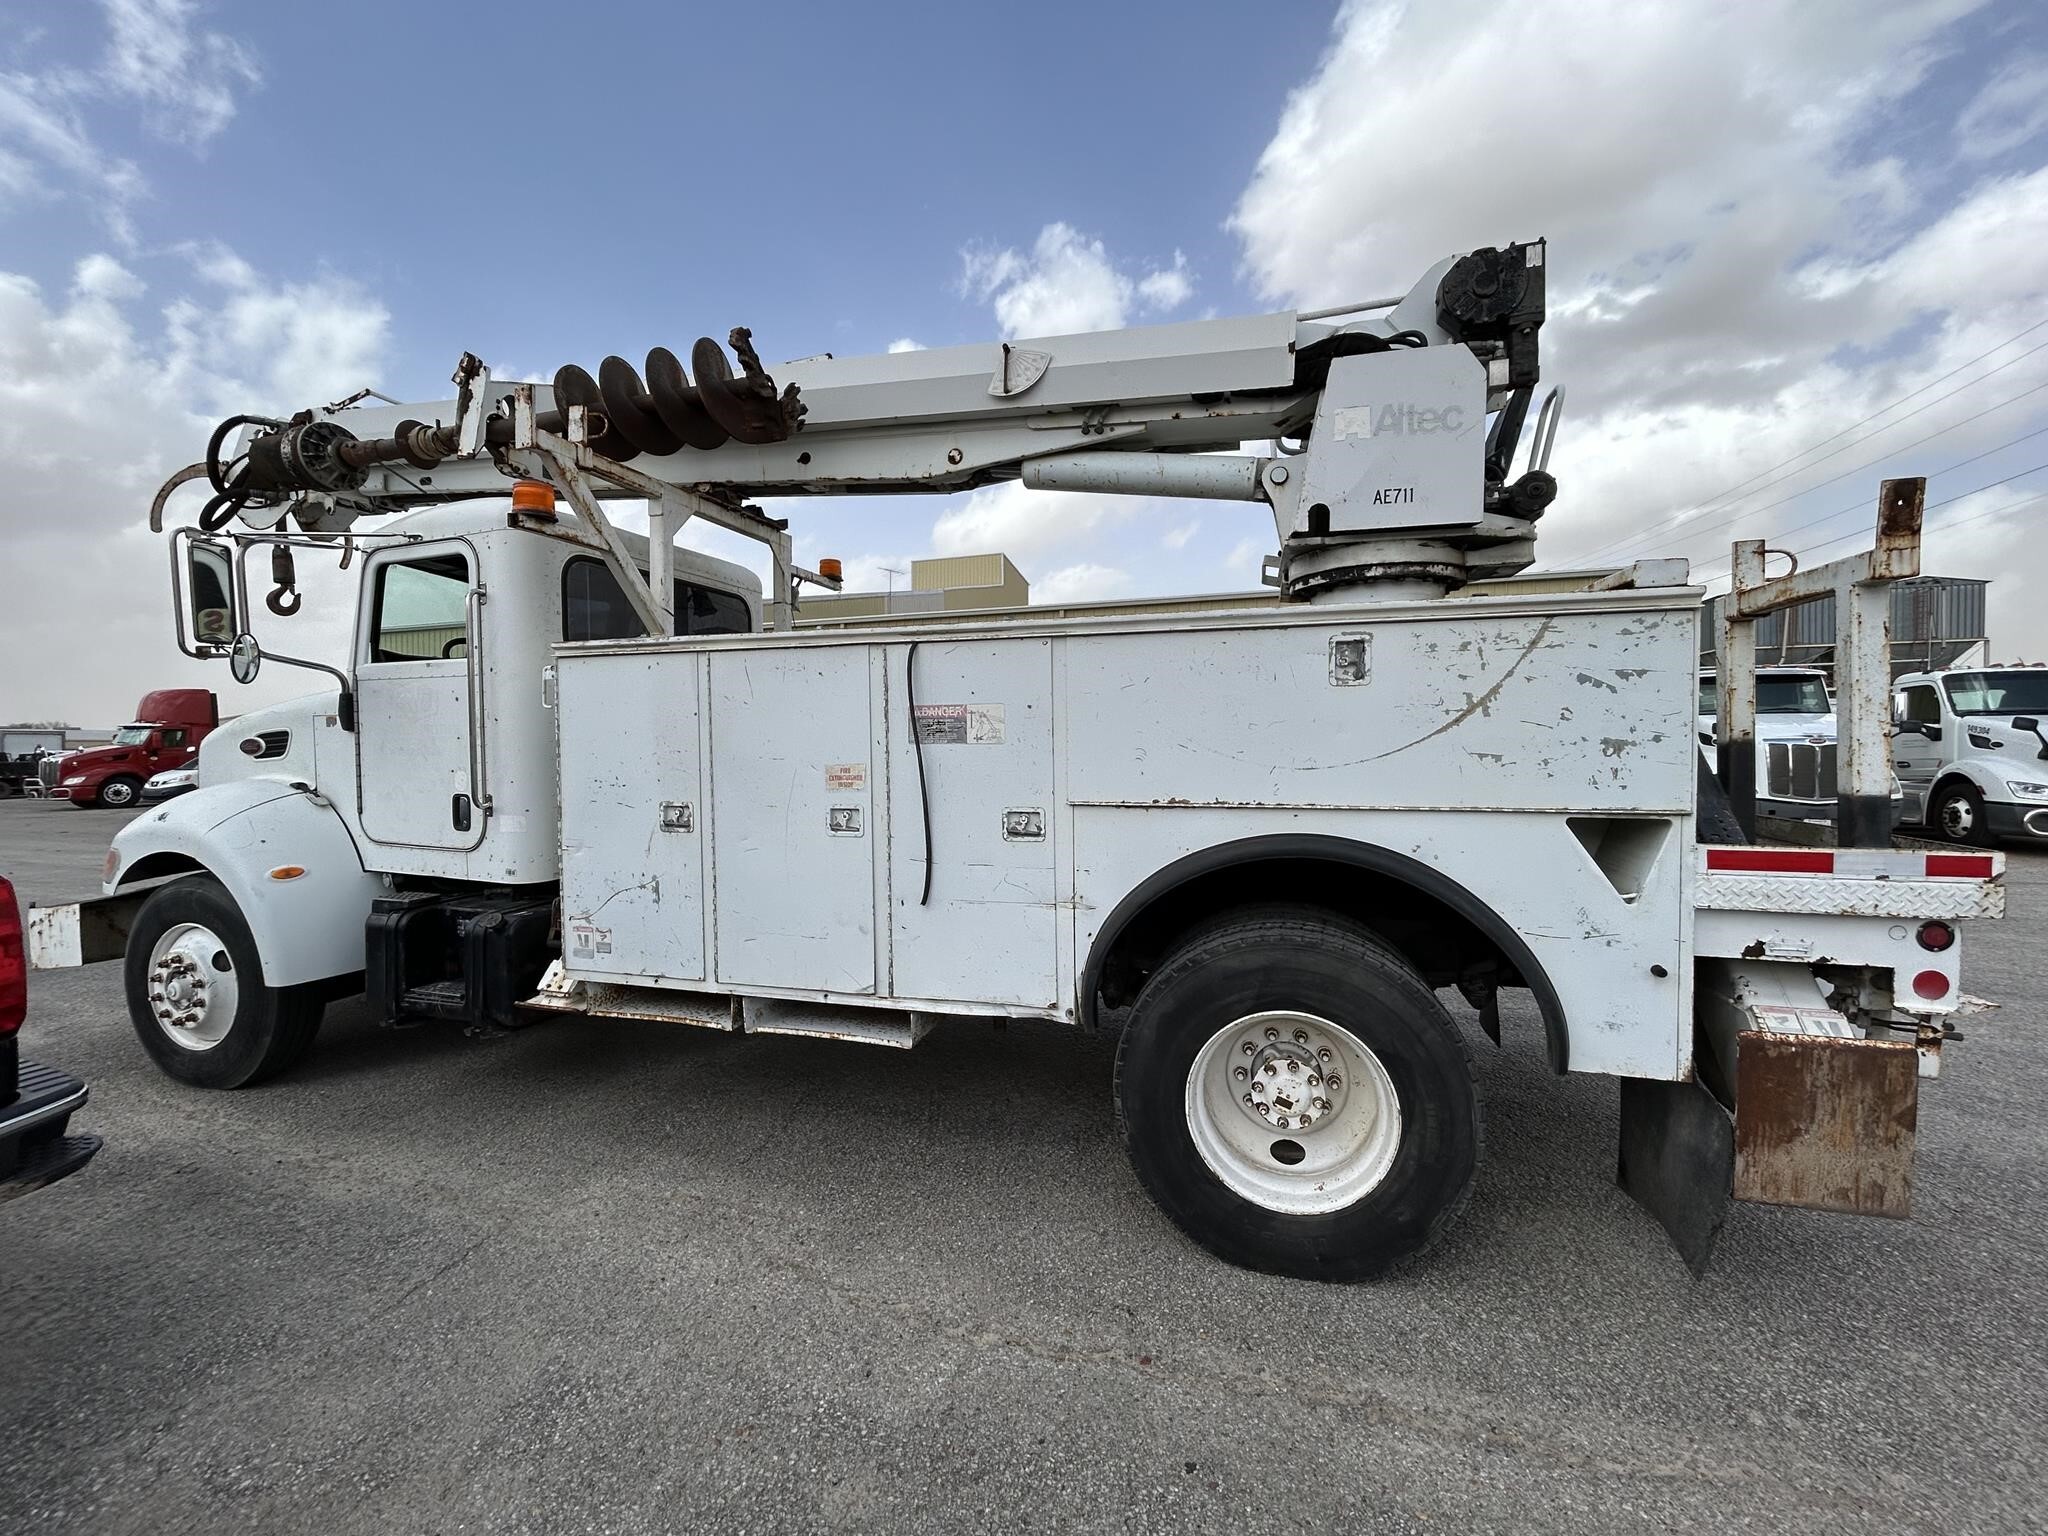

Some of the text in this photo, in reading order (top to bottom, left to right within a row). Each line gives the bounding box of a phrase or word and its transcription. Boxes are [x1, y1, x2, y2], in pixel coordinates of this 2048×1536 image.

[1373, 402, 1464, 436] Altec
[1373, 488, 1414, 505] AE711
[920, 706, 963, 717] DANGER
